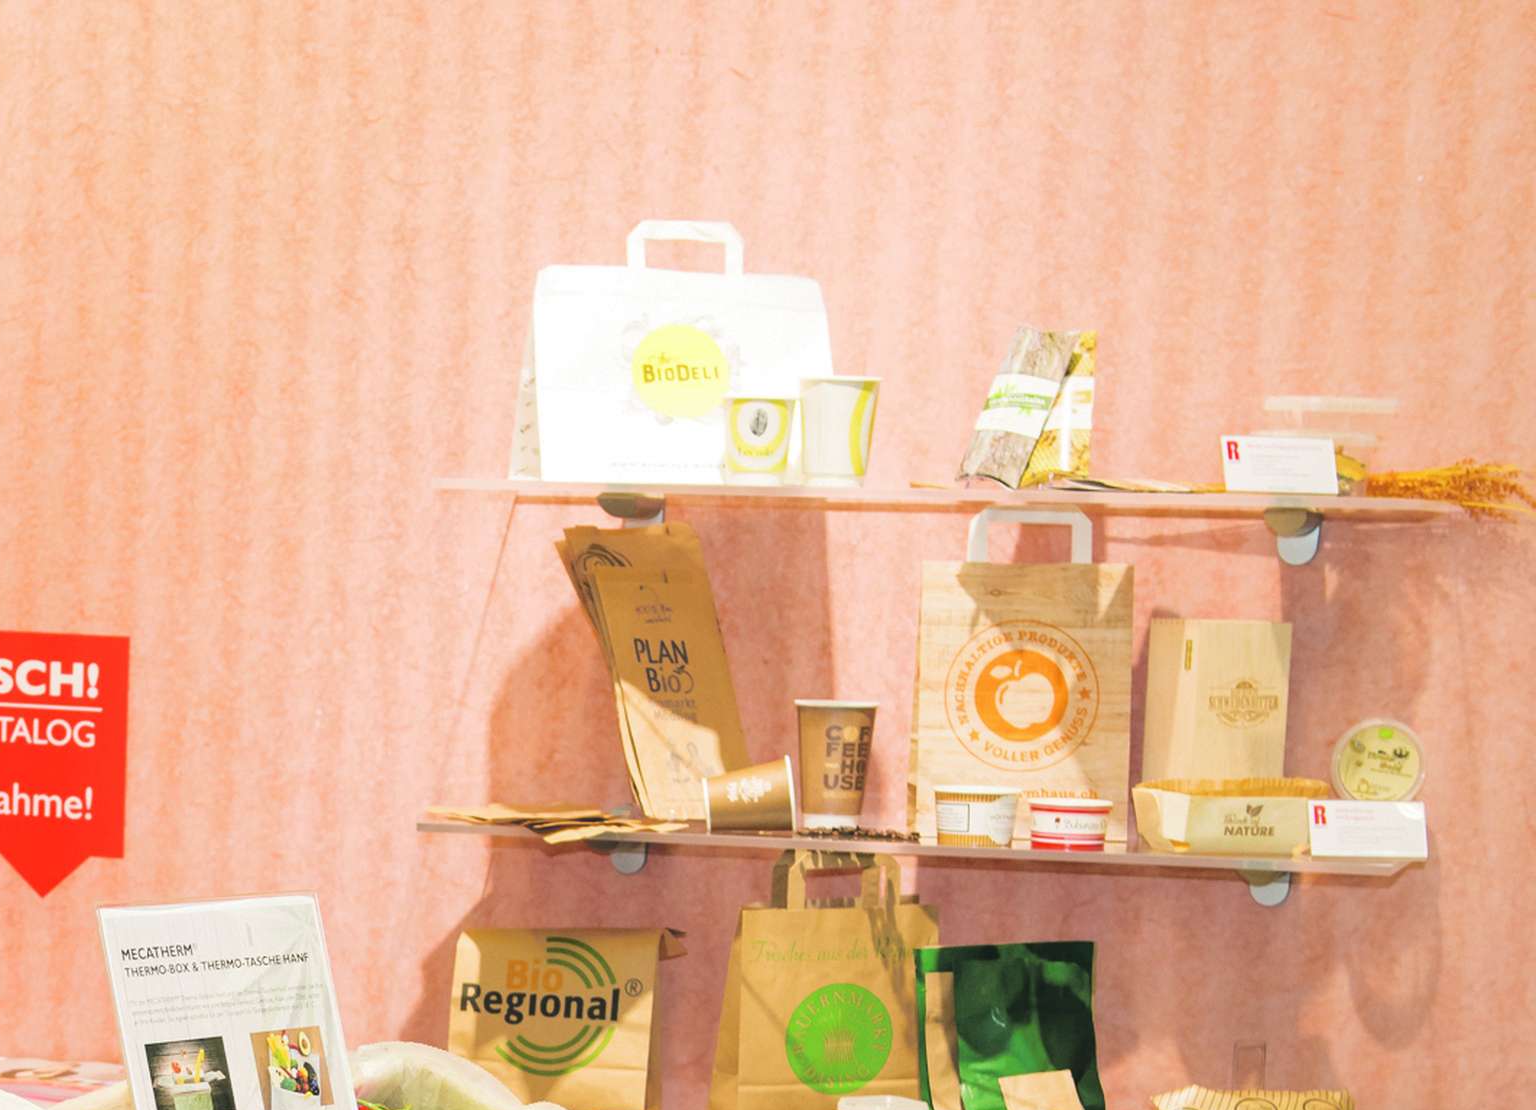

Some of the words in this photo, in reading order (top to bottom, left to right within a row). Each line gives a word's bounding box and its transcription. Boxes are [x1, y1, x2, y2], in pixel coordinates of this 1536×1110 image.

[633, 638, 689, 664] PLAN
[1018, 630, 1088, 683] PRODUKTE
[983, 740, 1040, 762] VOLLER
[1043, 706, 1089, 757] GENUSS
[1223, 825, 1276, 837] NATURE
[1313, 805, 1327, 825] R
[505, 959, 563, 992] Bio
[460, 983, 620, 1025] Regional
